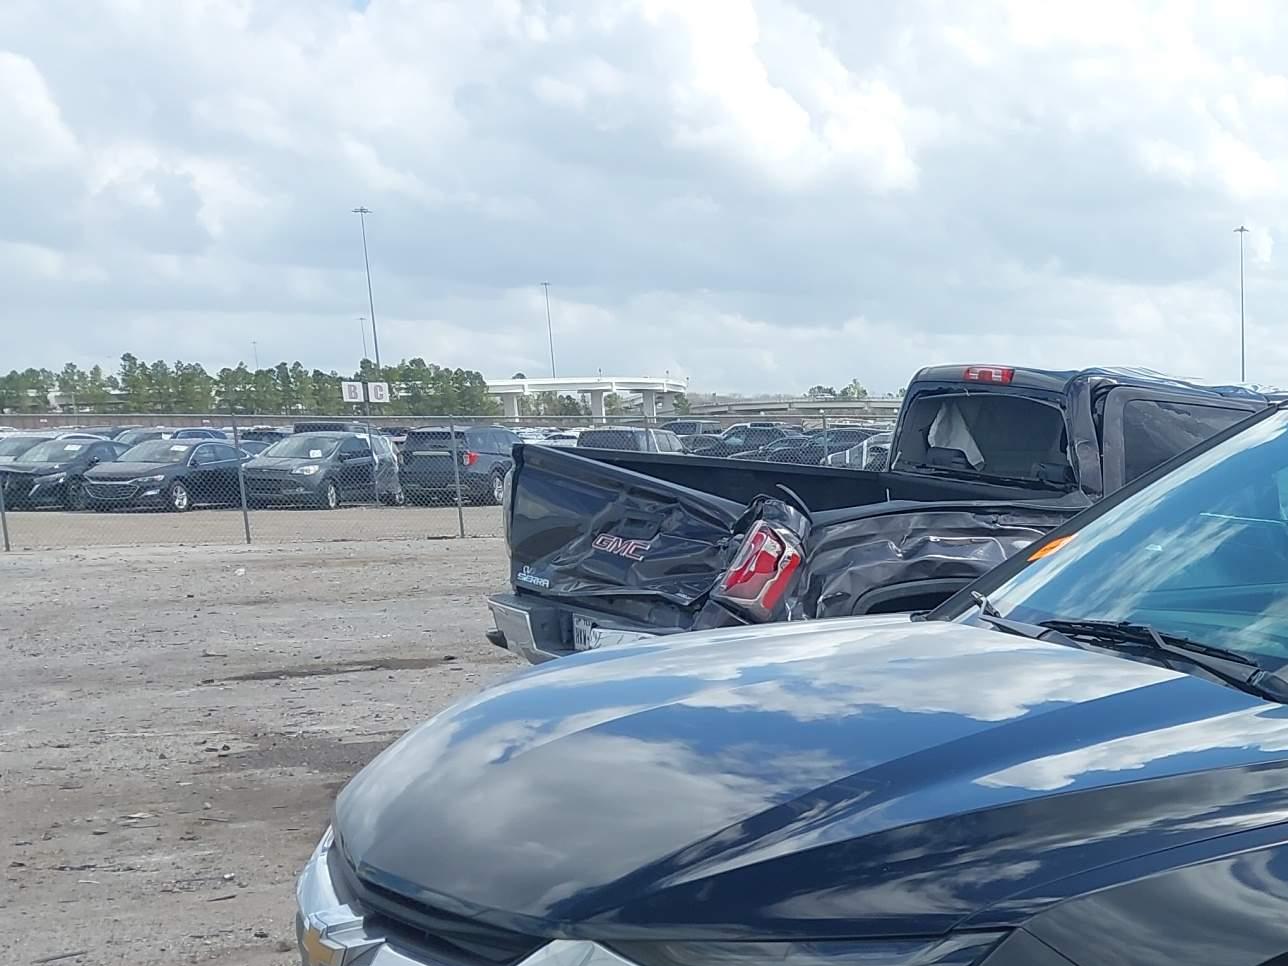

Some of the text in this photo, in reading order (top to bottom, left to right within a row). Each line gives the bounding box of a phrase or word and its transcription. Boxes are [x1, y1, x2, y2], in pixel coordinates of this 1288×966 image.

[347, 384, 359, 400] B
[373, 384, 385, 400] C
[592, 532, 650, 561] GMC
[517, 572, 550, 588] SIERRA
